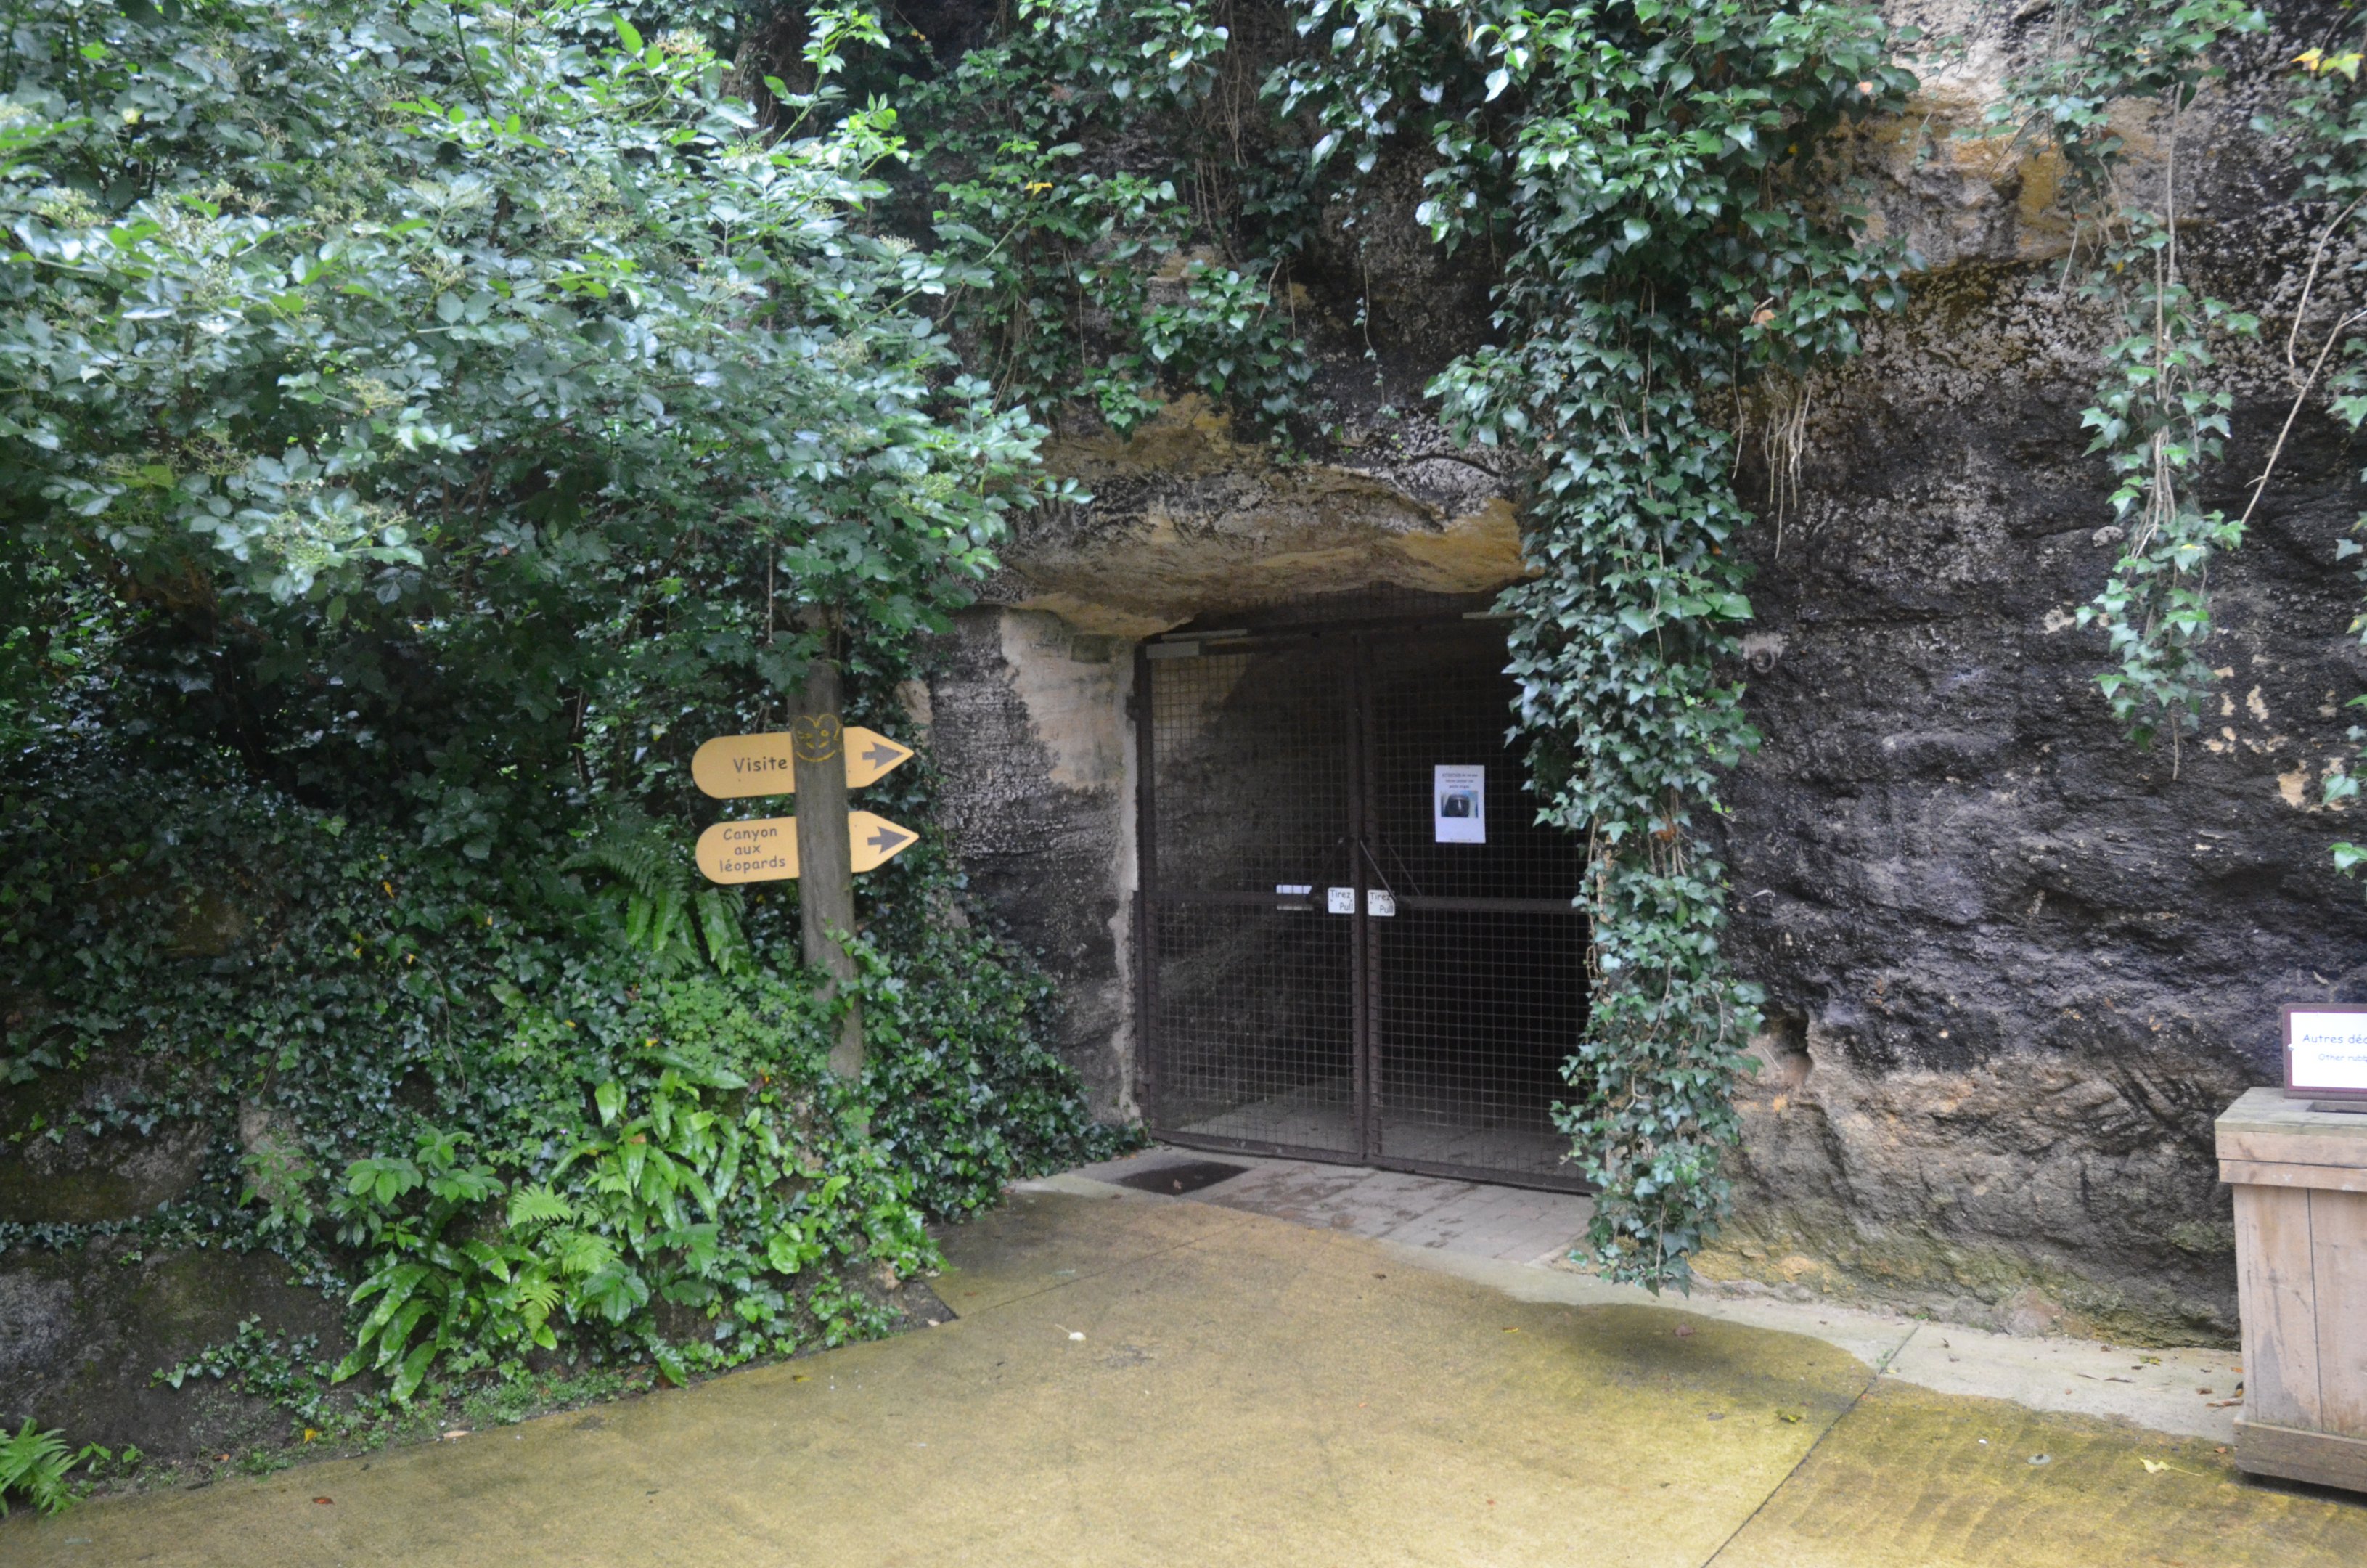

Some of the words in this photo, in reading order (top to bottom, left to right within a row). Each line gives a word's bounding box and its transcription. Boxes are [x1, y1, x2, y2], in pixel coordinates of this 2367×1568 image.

[733, 756, 788, 773] Visite
[723, 828, 777, 843] Canyon
[734, 845, 761, 855] aux
[719, 856, 786, 873] léopards
[1330, 889, 1351, 899] Tirez
[1370, 892, 1390, 901] Tirez
[1340, 902, 1353, 911] Pull
[1380, 905, 1394, 914] Pull
[2302, 1034, 2343, 1044] Autres
